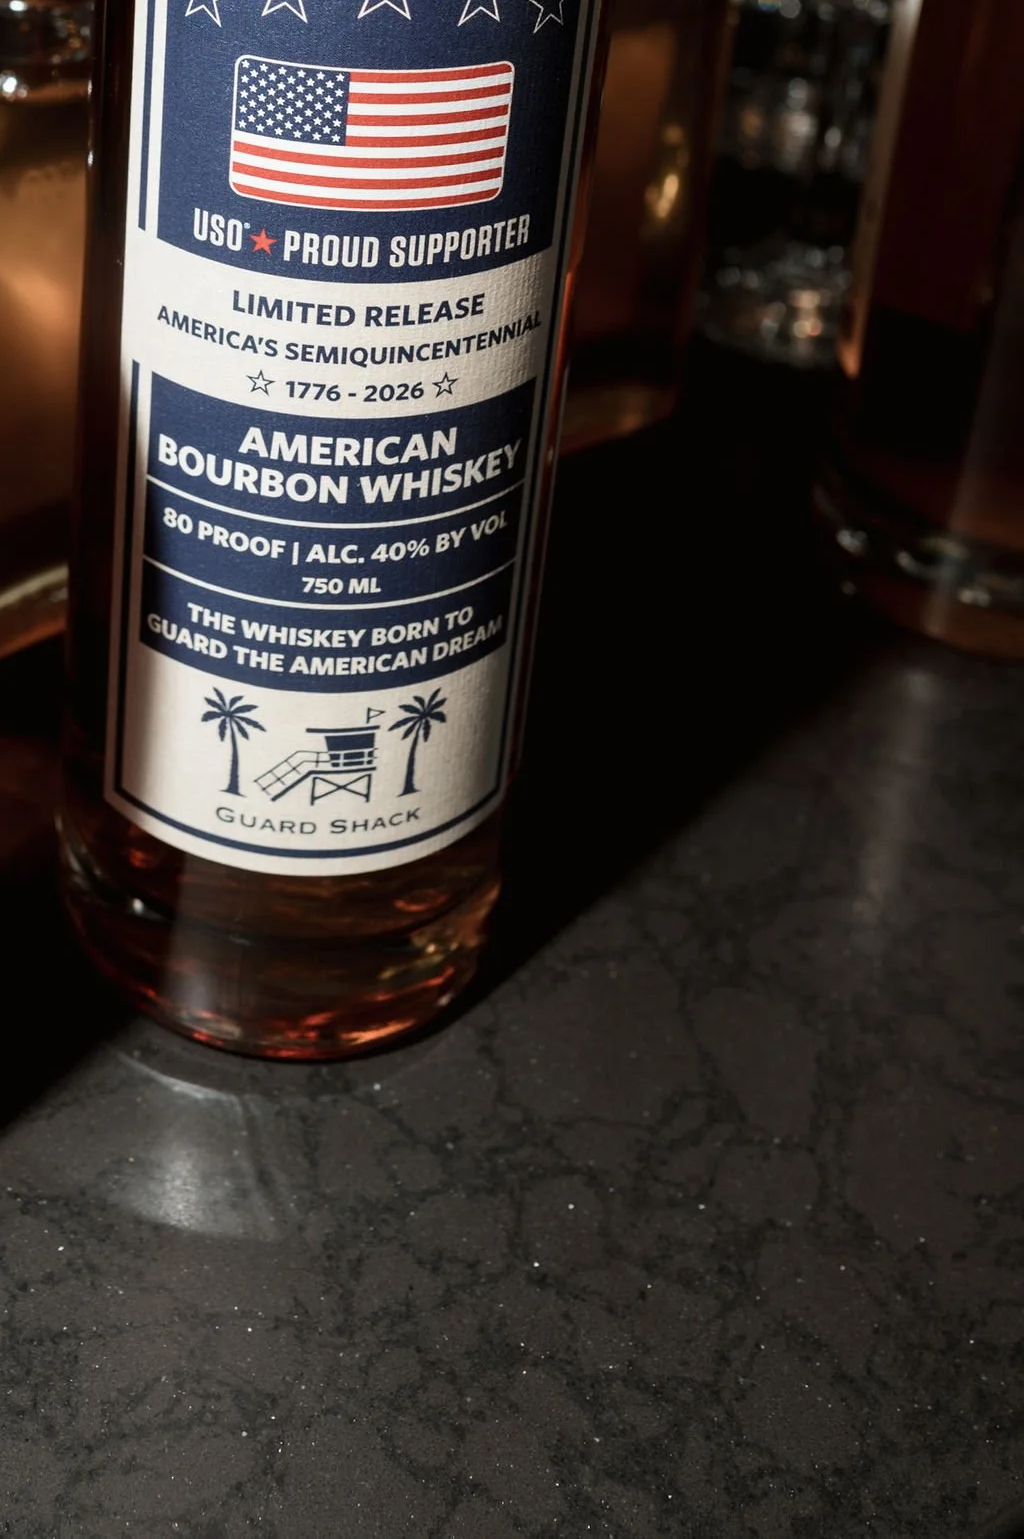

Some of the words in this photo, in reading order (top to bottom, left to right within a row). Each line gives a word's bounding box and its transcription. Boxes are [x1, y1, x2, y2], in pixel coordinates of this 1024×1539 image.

[283, 229, 380, 269] PROUD
[388, 213, 531, 268] SUPPORTER
[232, 289, 357, 328] LIMITED
[364, 292, 485, 327] RELEASE
[157, 305, 279, 358] AMERICA'S
[284, 310, 543, 368] SEMIQUINCENTENNIAL
[285, 380, 341, 402] 1776
[363, 381, 425, 402] 2026
[157, 433, 349, 505] BOURBON
[359, 438, 522, 505] WHISKEY
[238, 426, 458, 467] AMERICAN
[163, 507, 194, 535] 80
[197, 521, 286, 559] PROOF
[305, 541, 365, 564] ALC.
[371, 537, 430, 563] 40%
[435, 527, 467, 554] BY
[470, 510, 508, 541] VOL
[301, 576, 344, 594] 750
[348, 577, 381, 594] ML
[147, 614, 228, 660] GUARD
[233, 645, 285, 673] THE
[289, 647, 427, 676] AMERICAN
[432, 615, 504, 662] DREAM
[187, 602, 236, 635] THE
[241, 619, 367, 649] WHISKEY
[372, 617, 440, 647] BORN
[444, 606, 474, 631] TO
